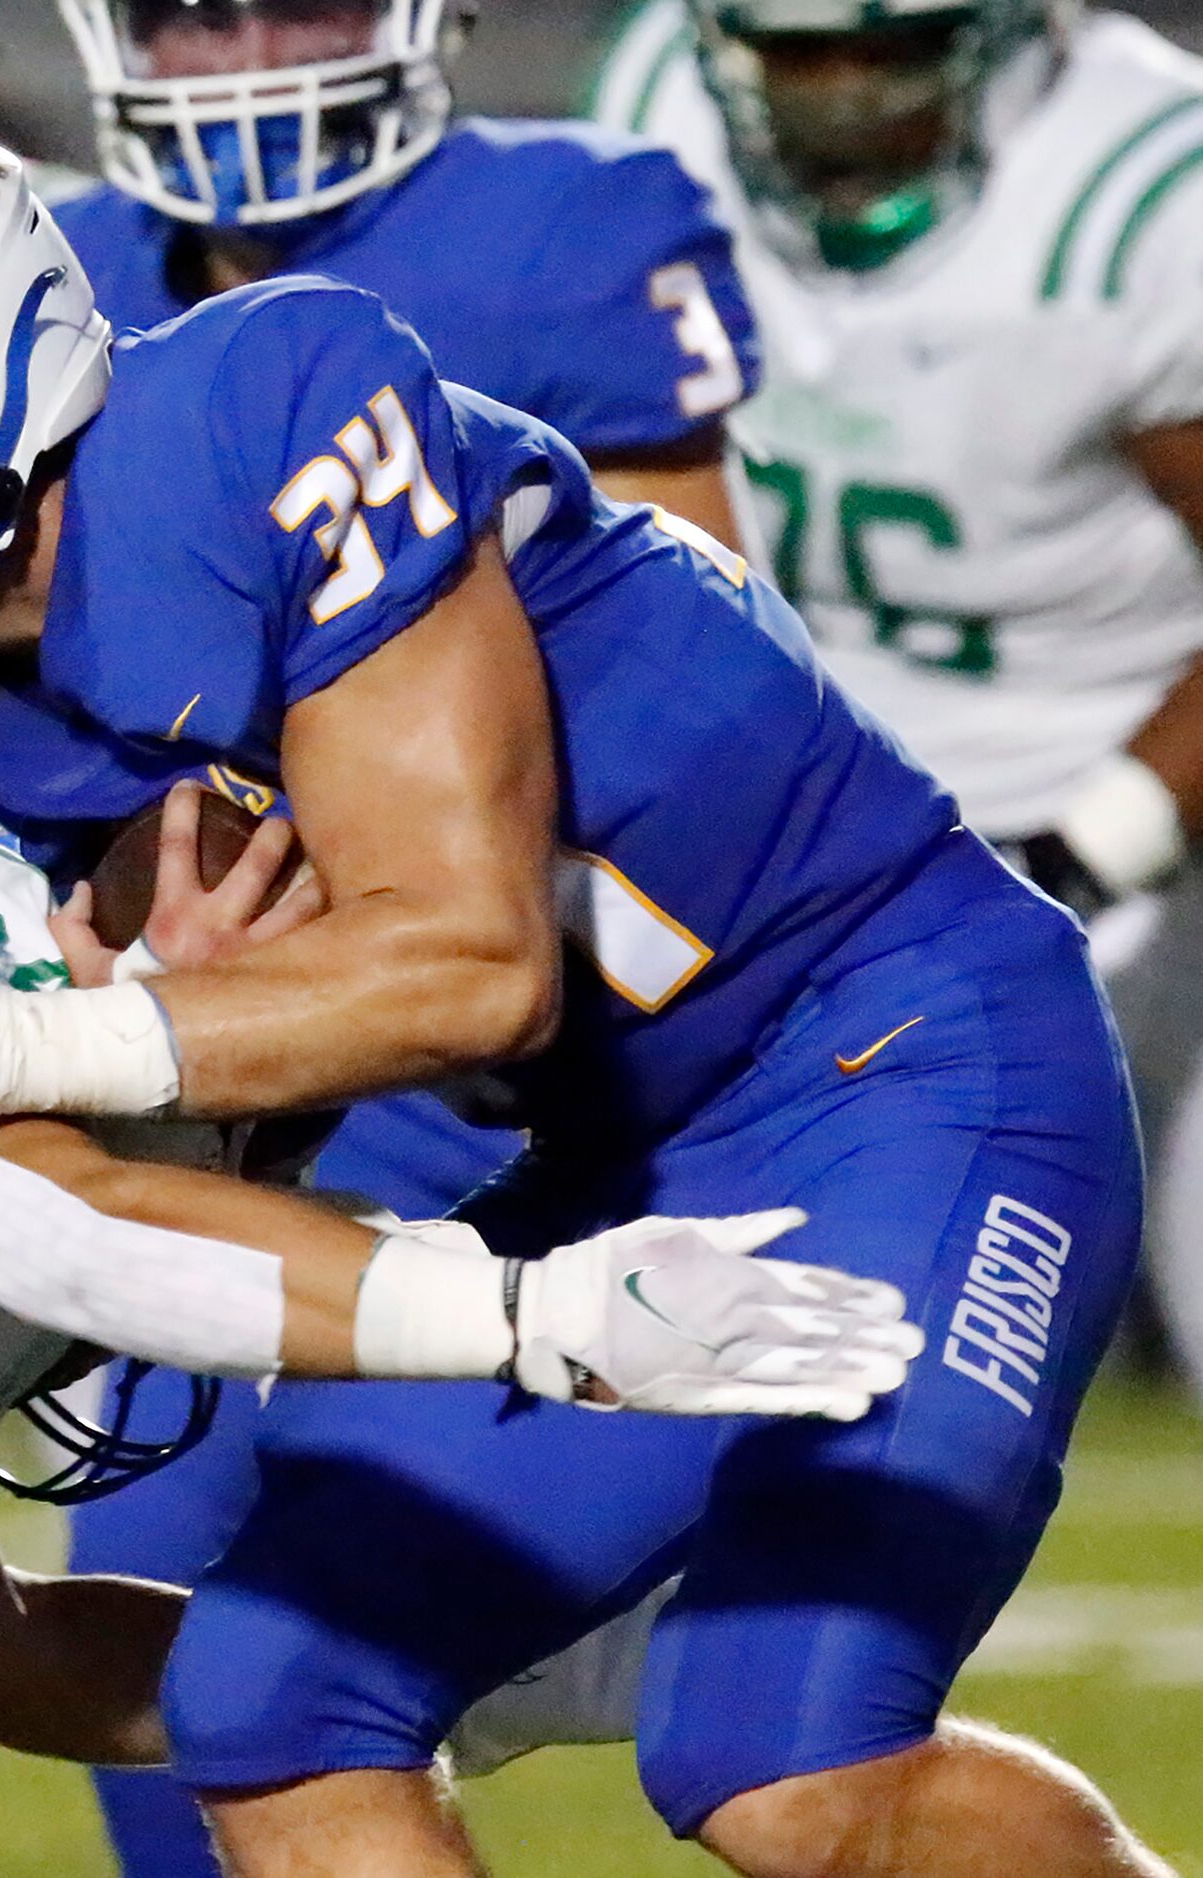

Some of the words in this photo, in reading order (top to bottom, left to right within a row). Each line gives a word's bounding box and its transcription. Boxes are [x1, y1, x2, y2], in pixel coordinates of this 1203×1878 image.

[651, 262, 744, 418] 3
[269, 385, 458, 626] 34
[942, 1194, 1072, 1418] FRISCO
